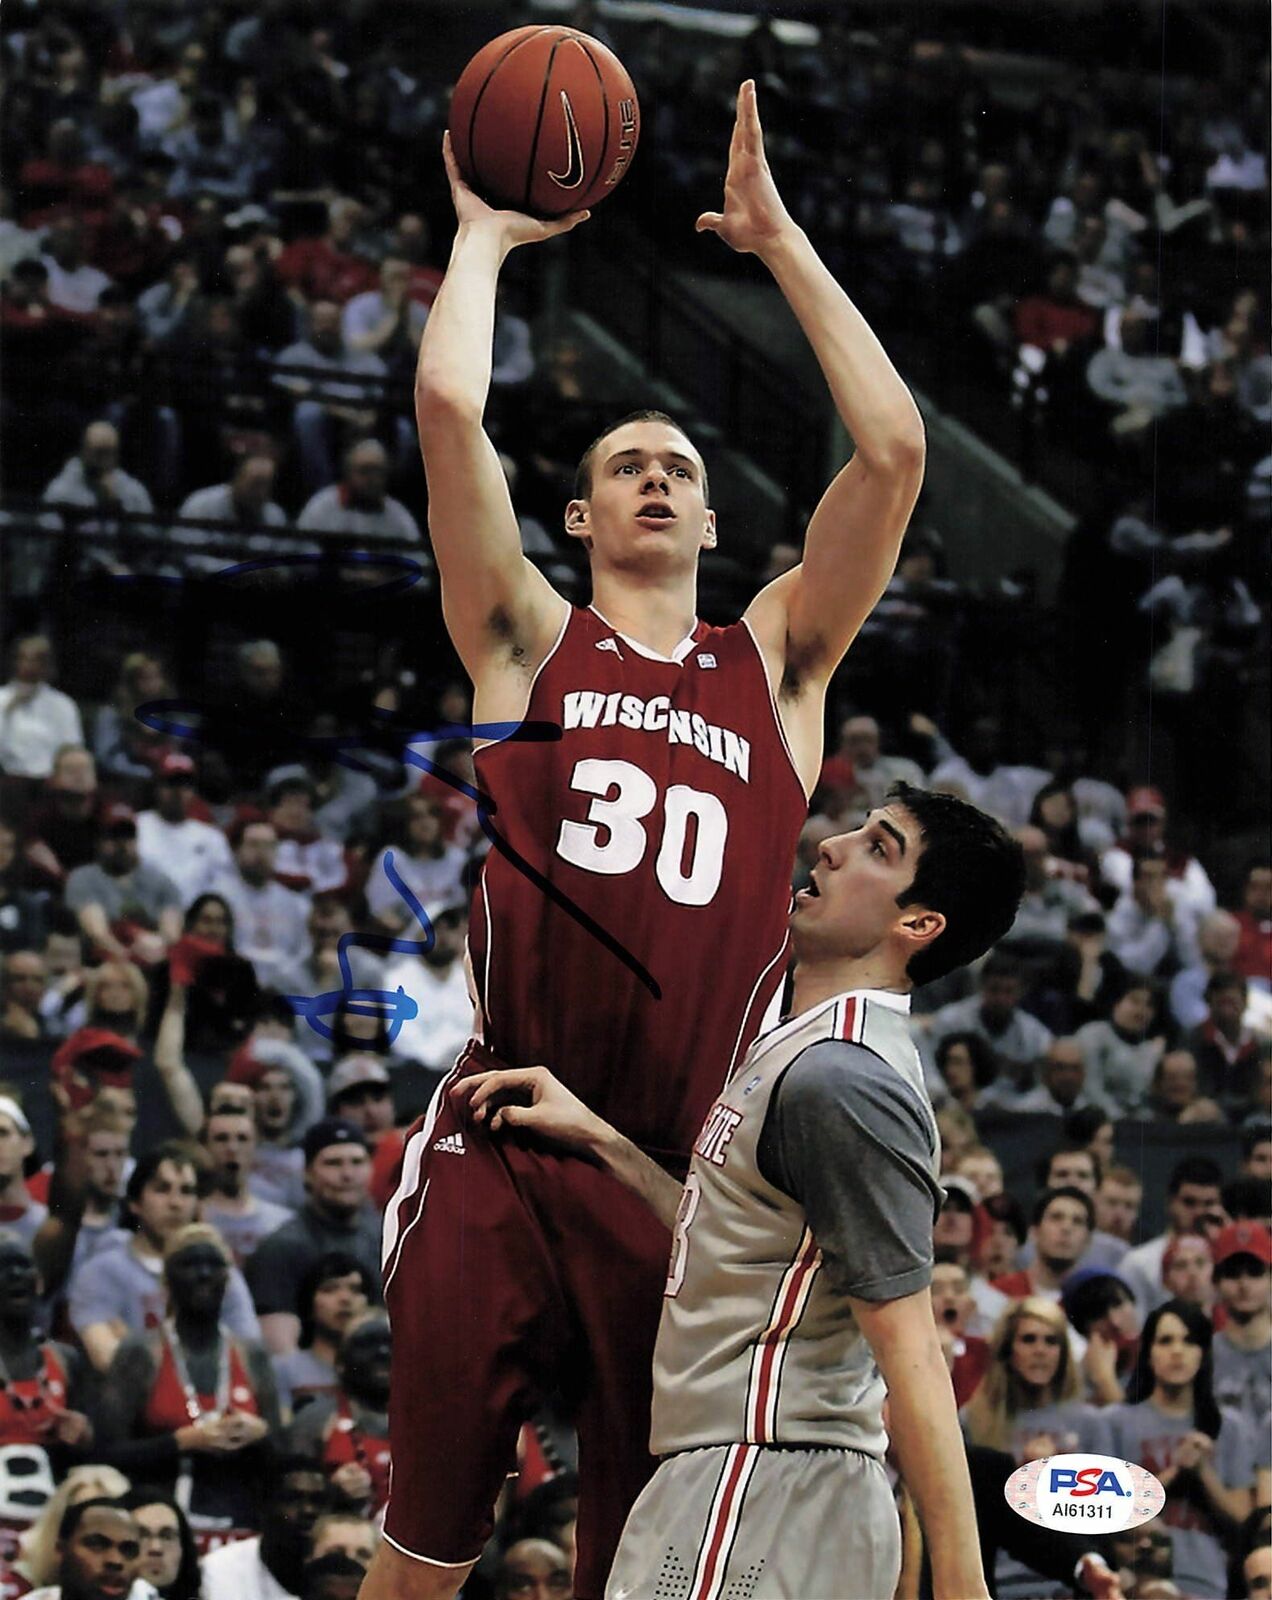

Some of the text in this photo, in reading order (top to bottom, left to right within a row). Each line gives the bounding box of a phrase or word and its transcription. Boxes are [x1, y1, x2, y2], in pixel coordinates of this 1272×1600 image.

[563, 690, 750, 784] WISCNSIN
[556, 757, 729, 906] 30
[433, 1142, 467, 1155] adidas
